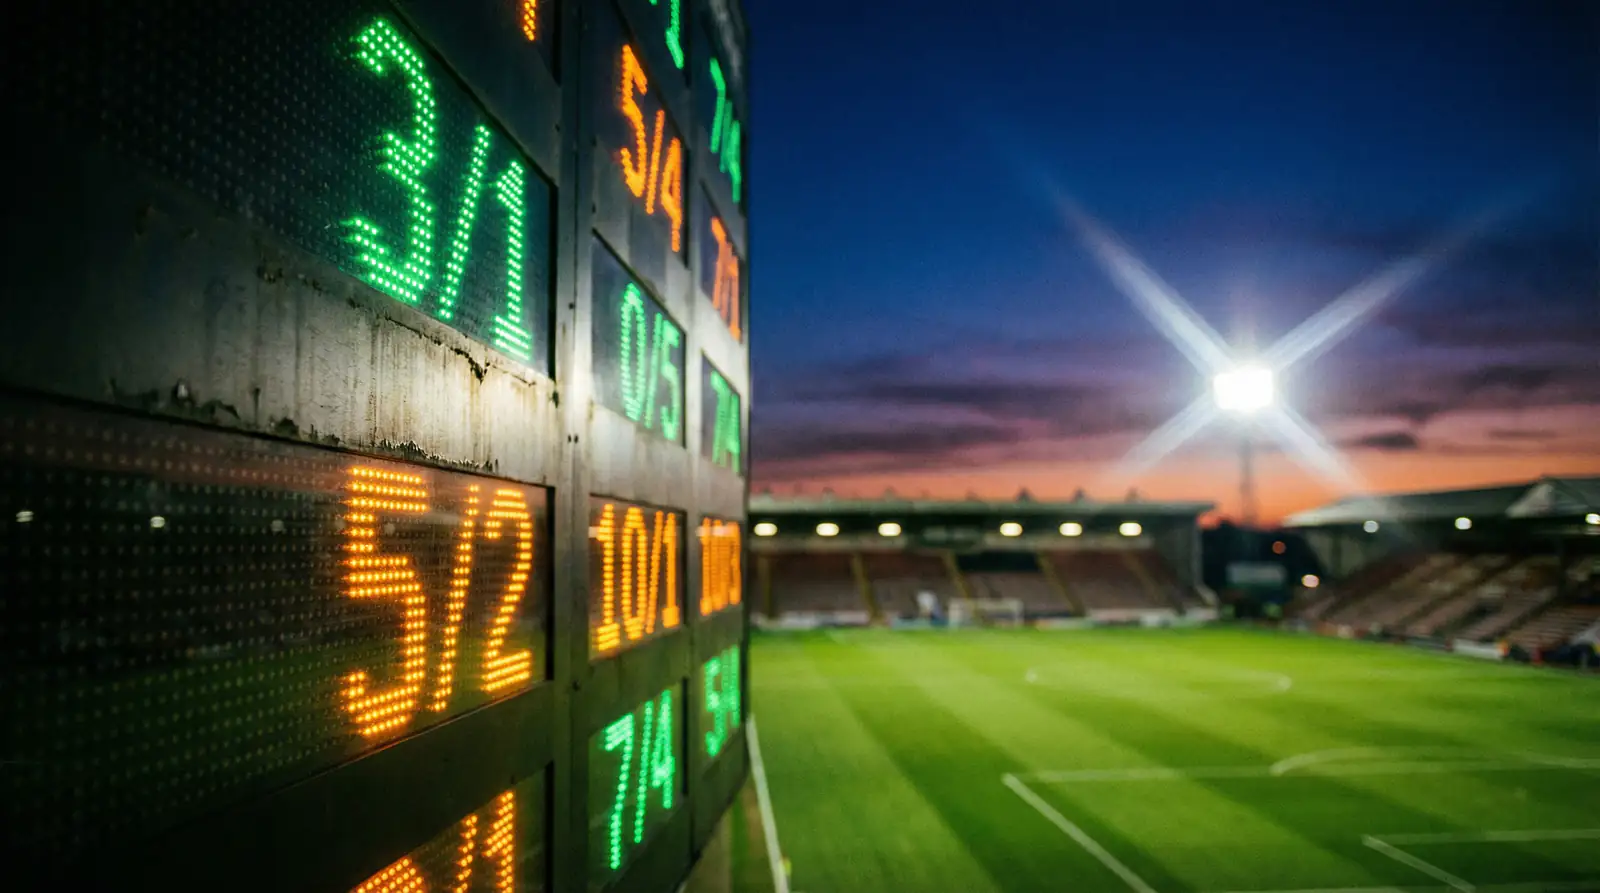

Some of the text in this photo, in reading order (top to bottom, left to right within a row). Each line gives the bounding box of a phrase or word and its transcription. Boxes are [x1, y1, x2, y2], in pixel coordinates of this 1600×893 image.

[342, 18, 532, 362] 3/1
[619, 44, 683, 253] 5/4
[619, 282, 680, 441] 0/5
[342, 466, 533, 737] 5/2
[596, 503, 680, 652] 10/1
[601, 689, 676, 870] 7/4
